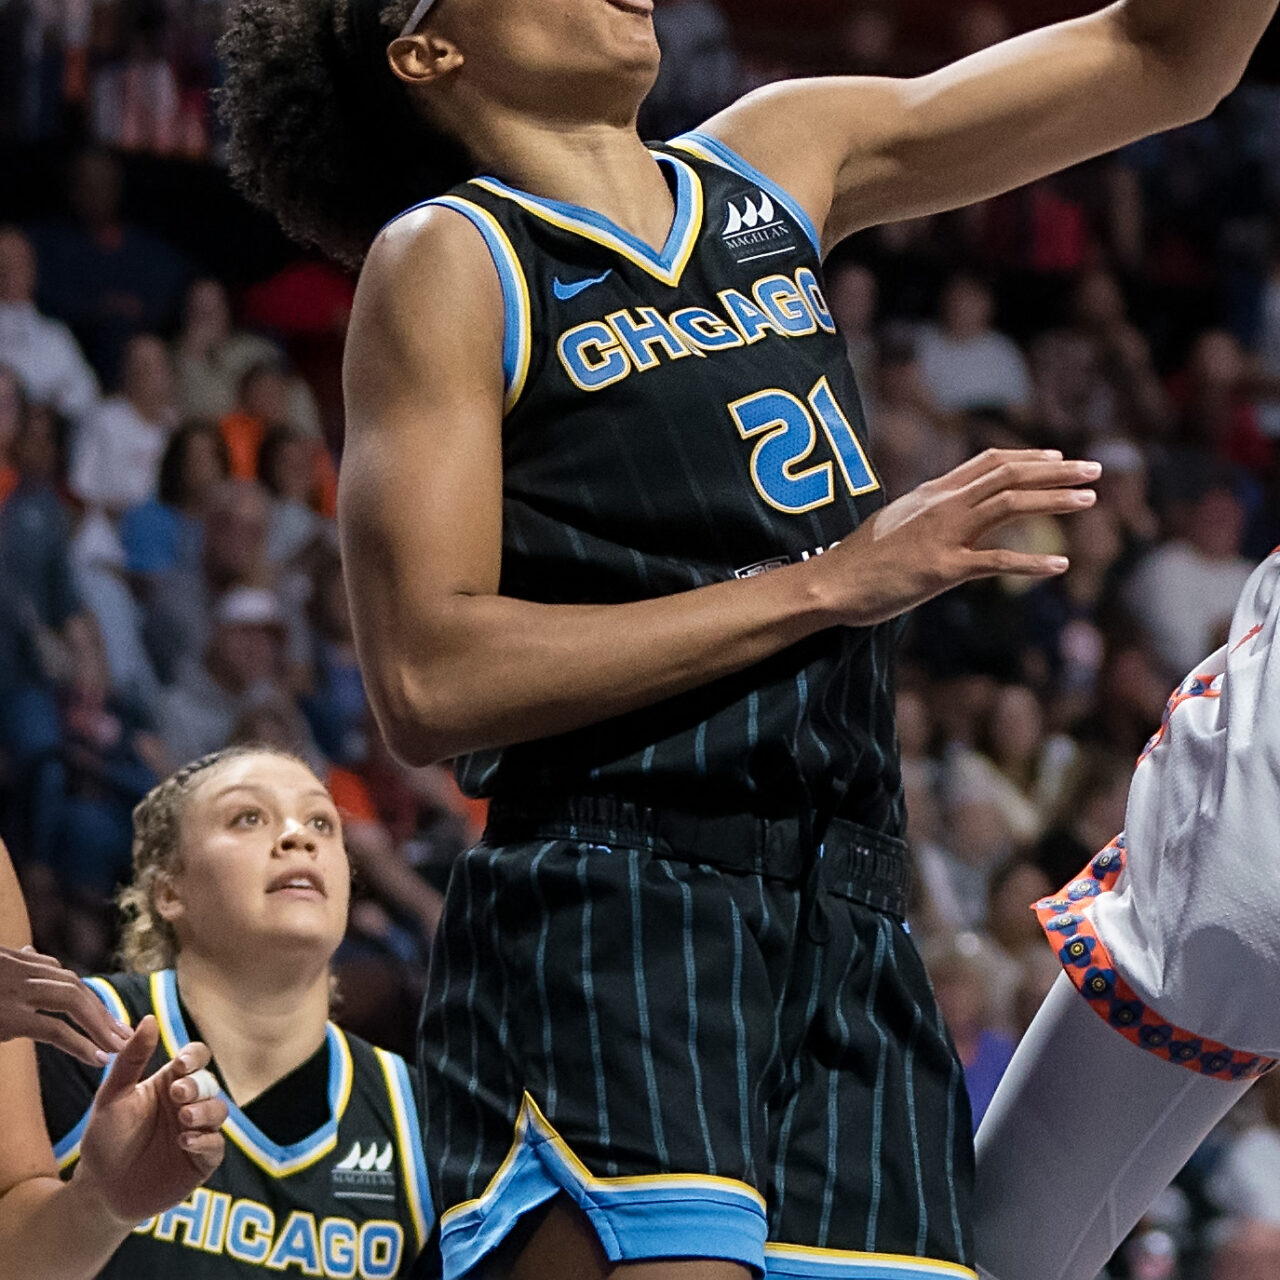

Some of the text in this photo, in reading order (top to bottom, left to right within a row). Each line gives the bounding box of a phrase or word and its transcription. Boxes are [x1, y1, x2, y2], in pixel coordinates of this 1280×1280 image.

[725, 226, 789, 249] MAGELLAN
[556, 266, 837, 392] CHCAGO
[727, 374, 880, 515] 21
[133, 1186, 405, 1280] HICAGO
